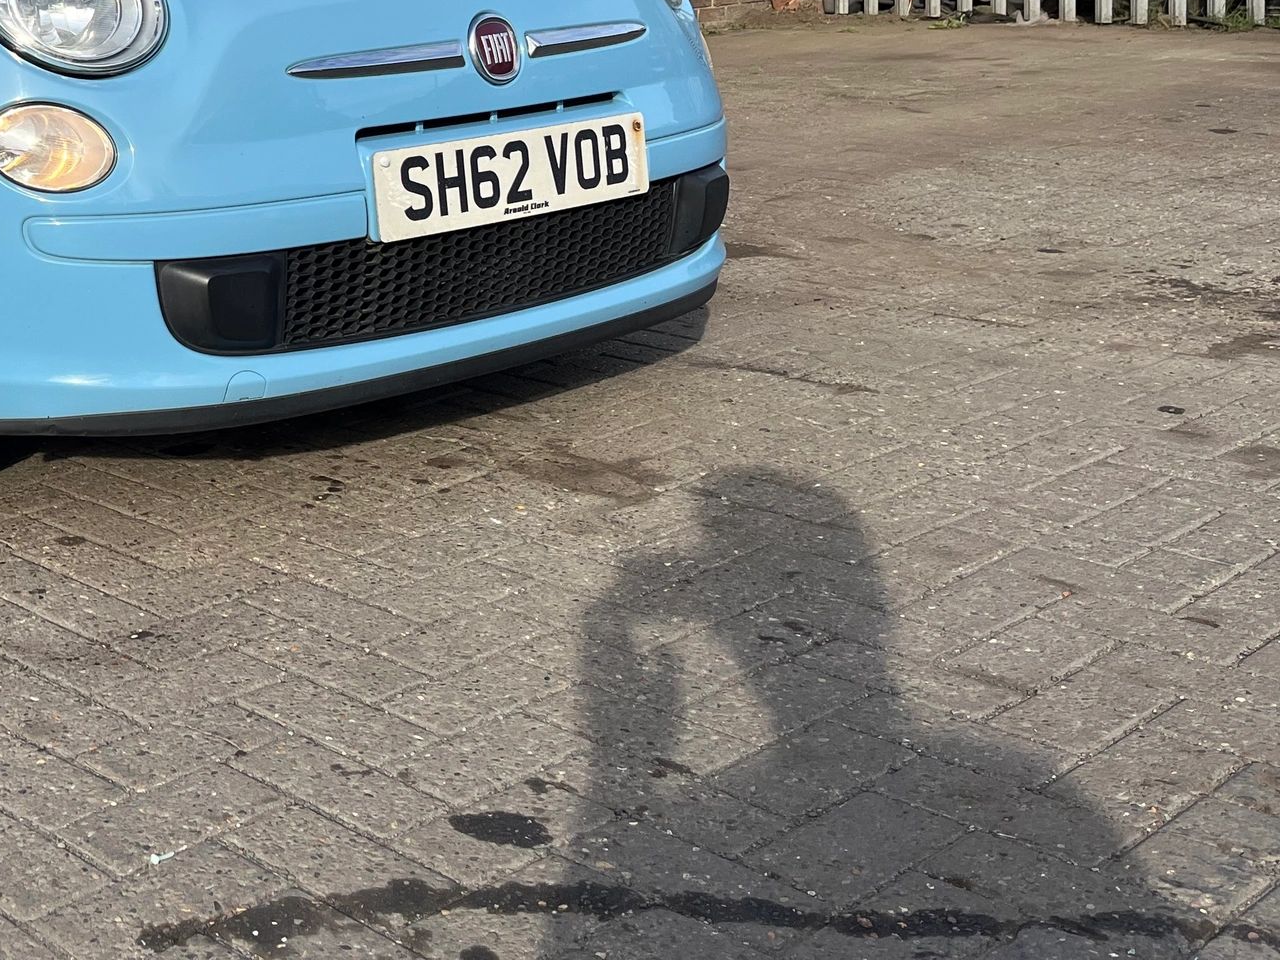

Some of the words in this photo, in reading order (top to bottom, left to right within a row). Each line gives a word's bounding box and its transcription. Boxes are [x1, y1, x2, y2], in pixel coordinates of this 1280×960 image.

[480, 31, 513, 65] FIAT
[400, 140, 533, 222] SH62
[544, 123, 629, 195] VOB
